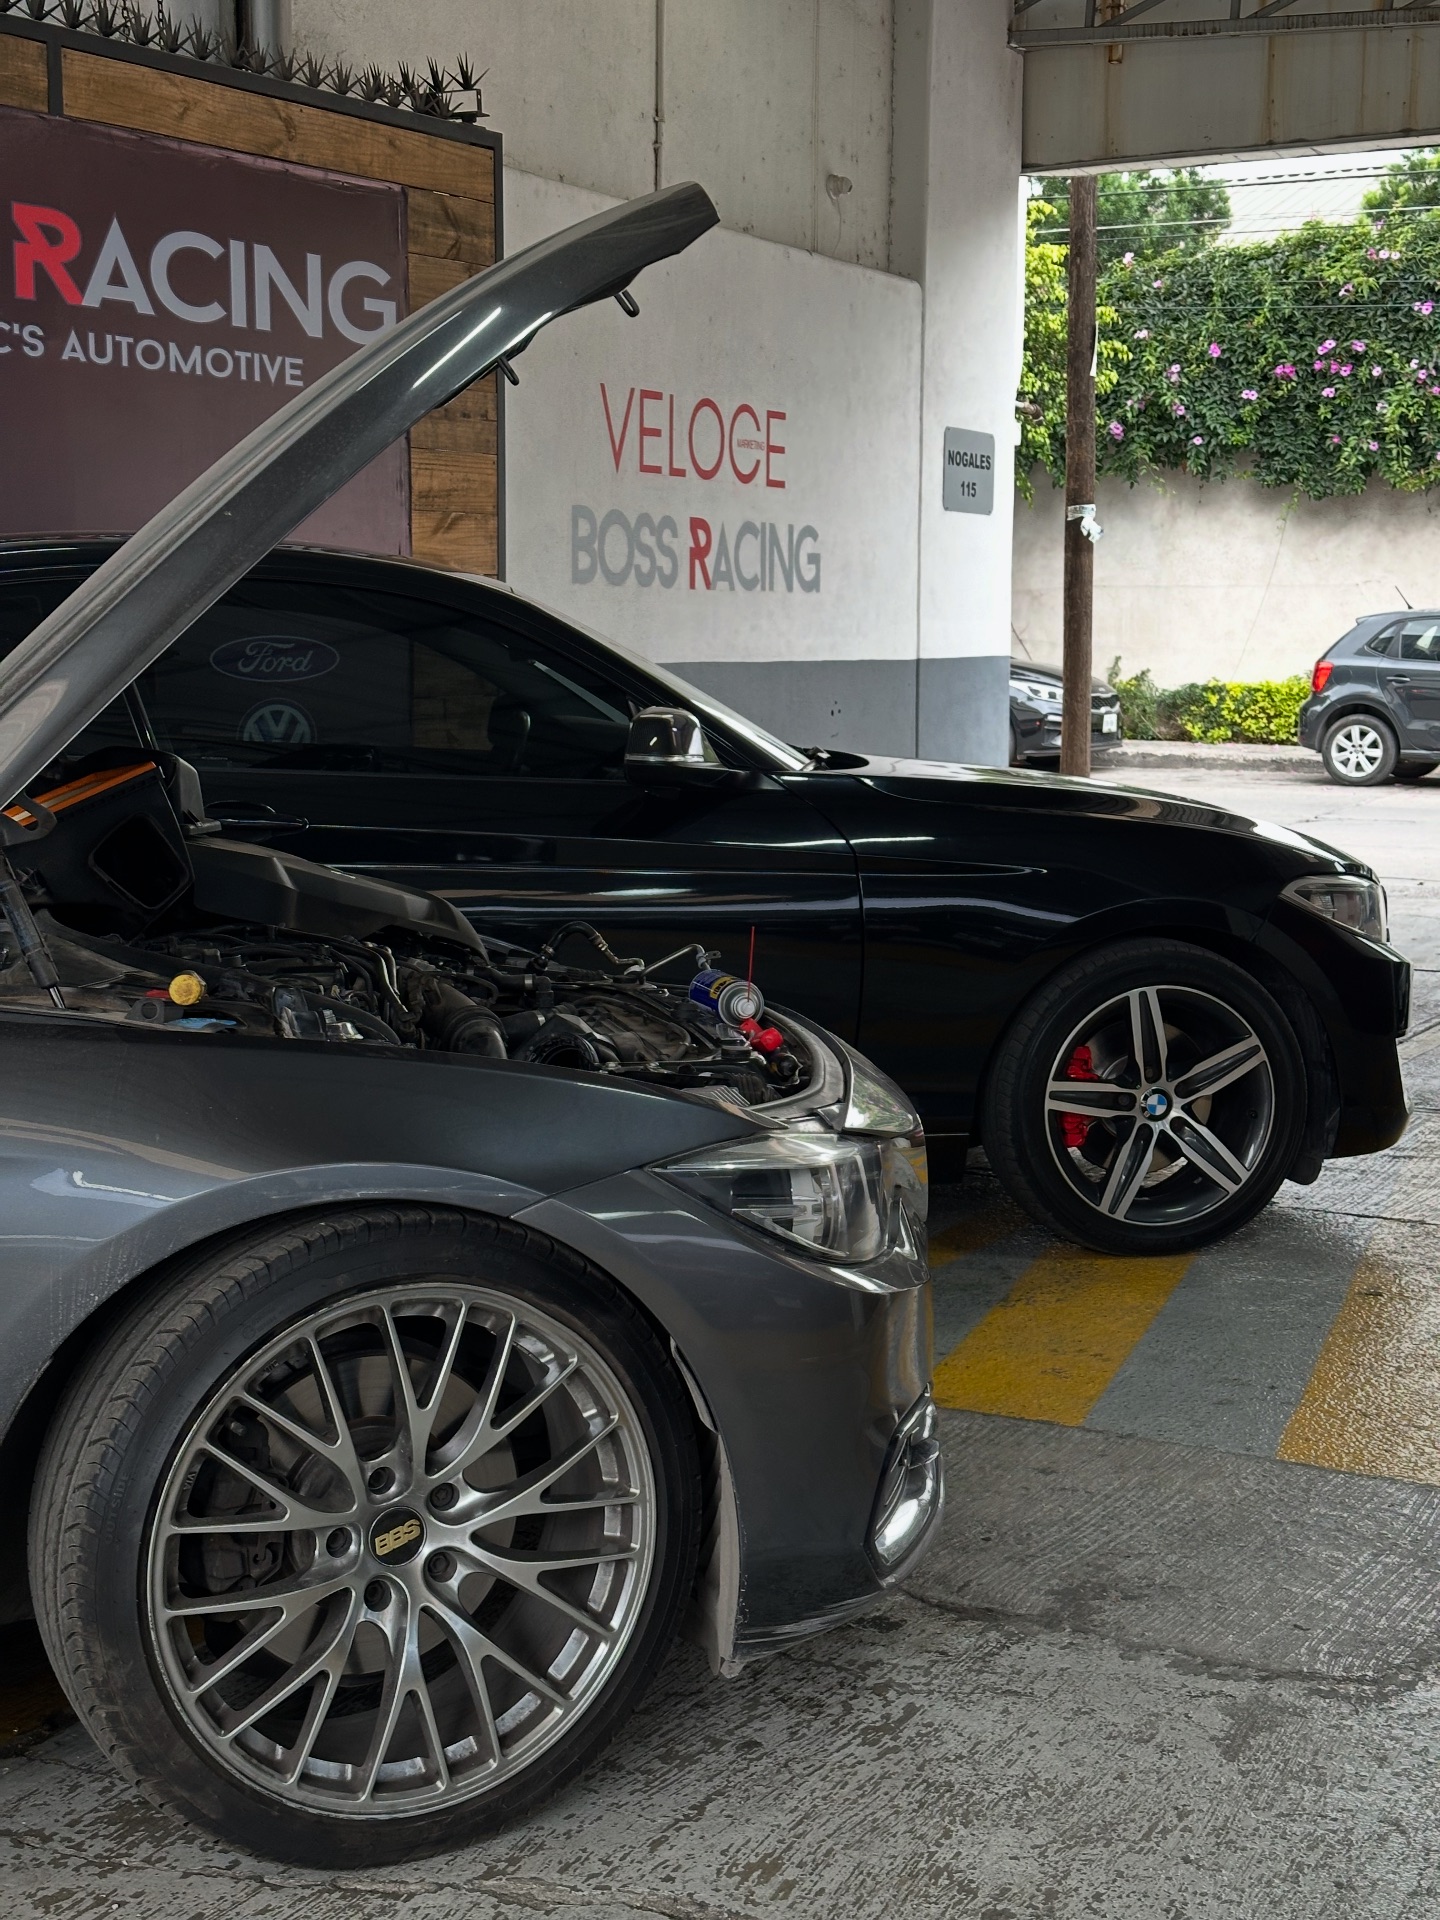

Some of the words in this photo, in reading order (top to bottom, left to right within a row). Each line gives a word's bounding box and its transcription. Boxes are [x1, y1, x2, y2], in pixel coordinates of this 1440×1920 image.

[12, 201, 397, 346] RACING
[61, 329, 304, 387] AUTOMOTIVE
[600, 382, 787, 489] VELOCE
[947, 449, 992, 471] NOGALES
[960, 480, 977, 498] 115
[571, 504, 679, 590] BOSS
[689, 516, 821, 593] RACING
[237, 641, 314, 673] Ford
[374, 1518, 421, 1556] BBS
